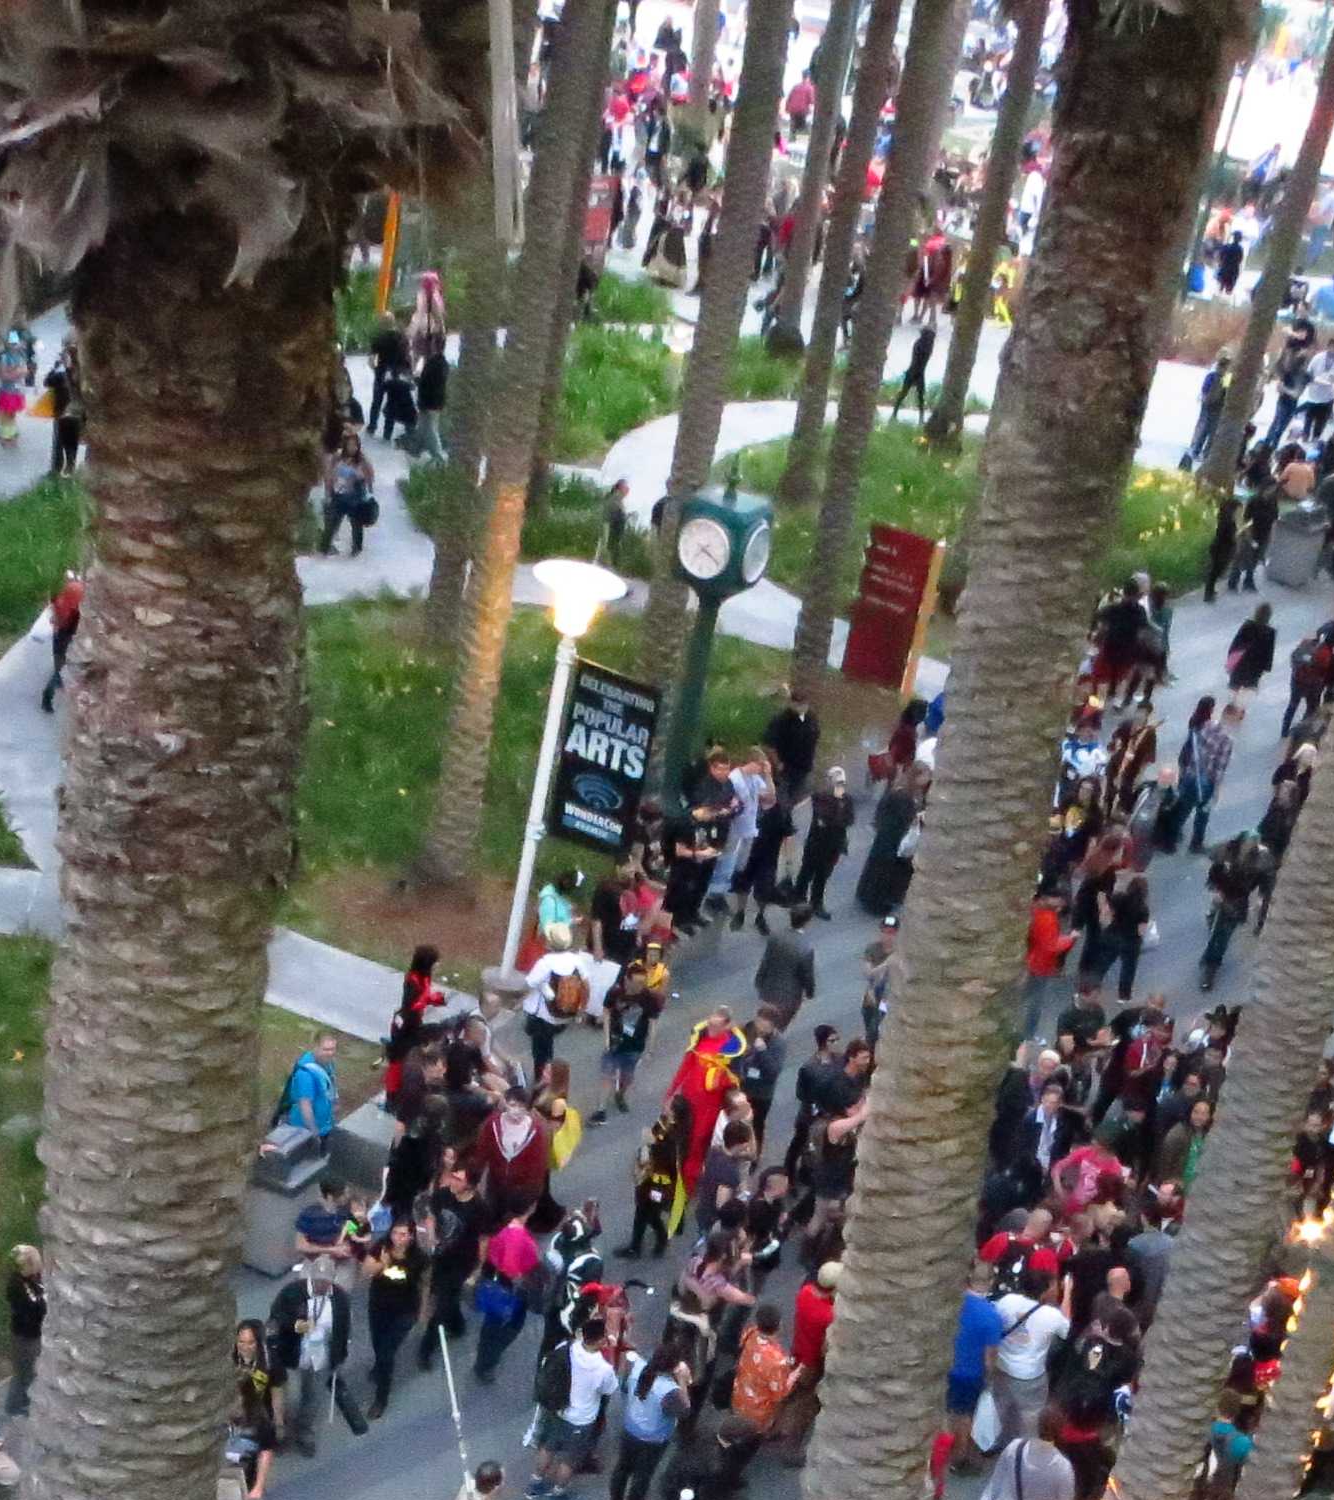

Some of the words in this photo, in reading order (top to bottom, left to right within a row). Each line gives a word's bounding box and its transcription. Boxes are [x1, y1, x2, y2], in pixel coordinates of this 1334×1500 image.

[580, 674, 655, 713] CELEBRATING
[573, 701, 650, 747] POPULAR
[565, 723, 646, 779] ARTS
